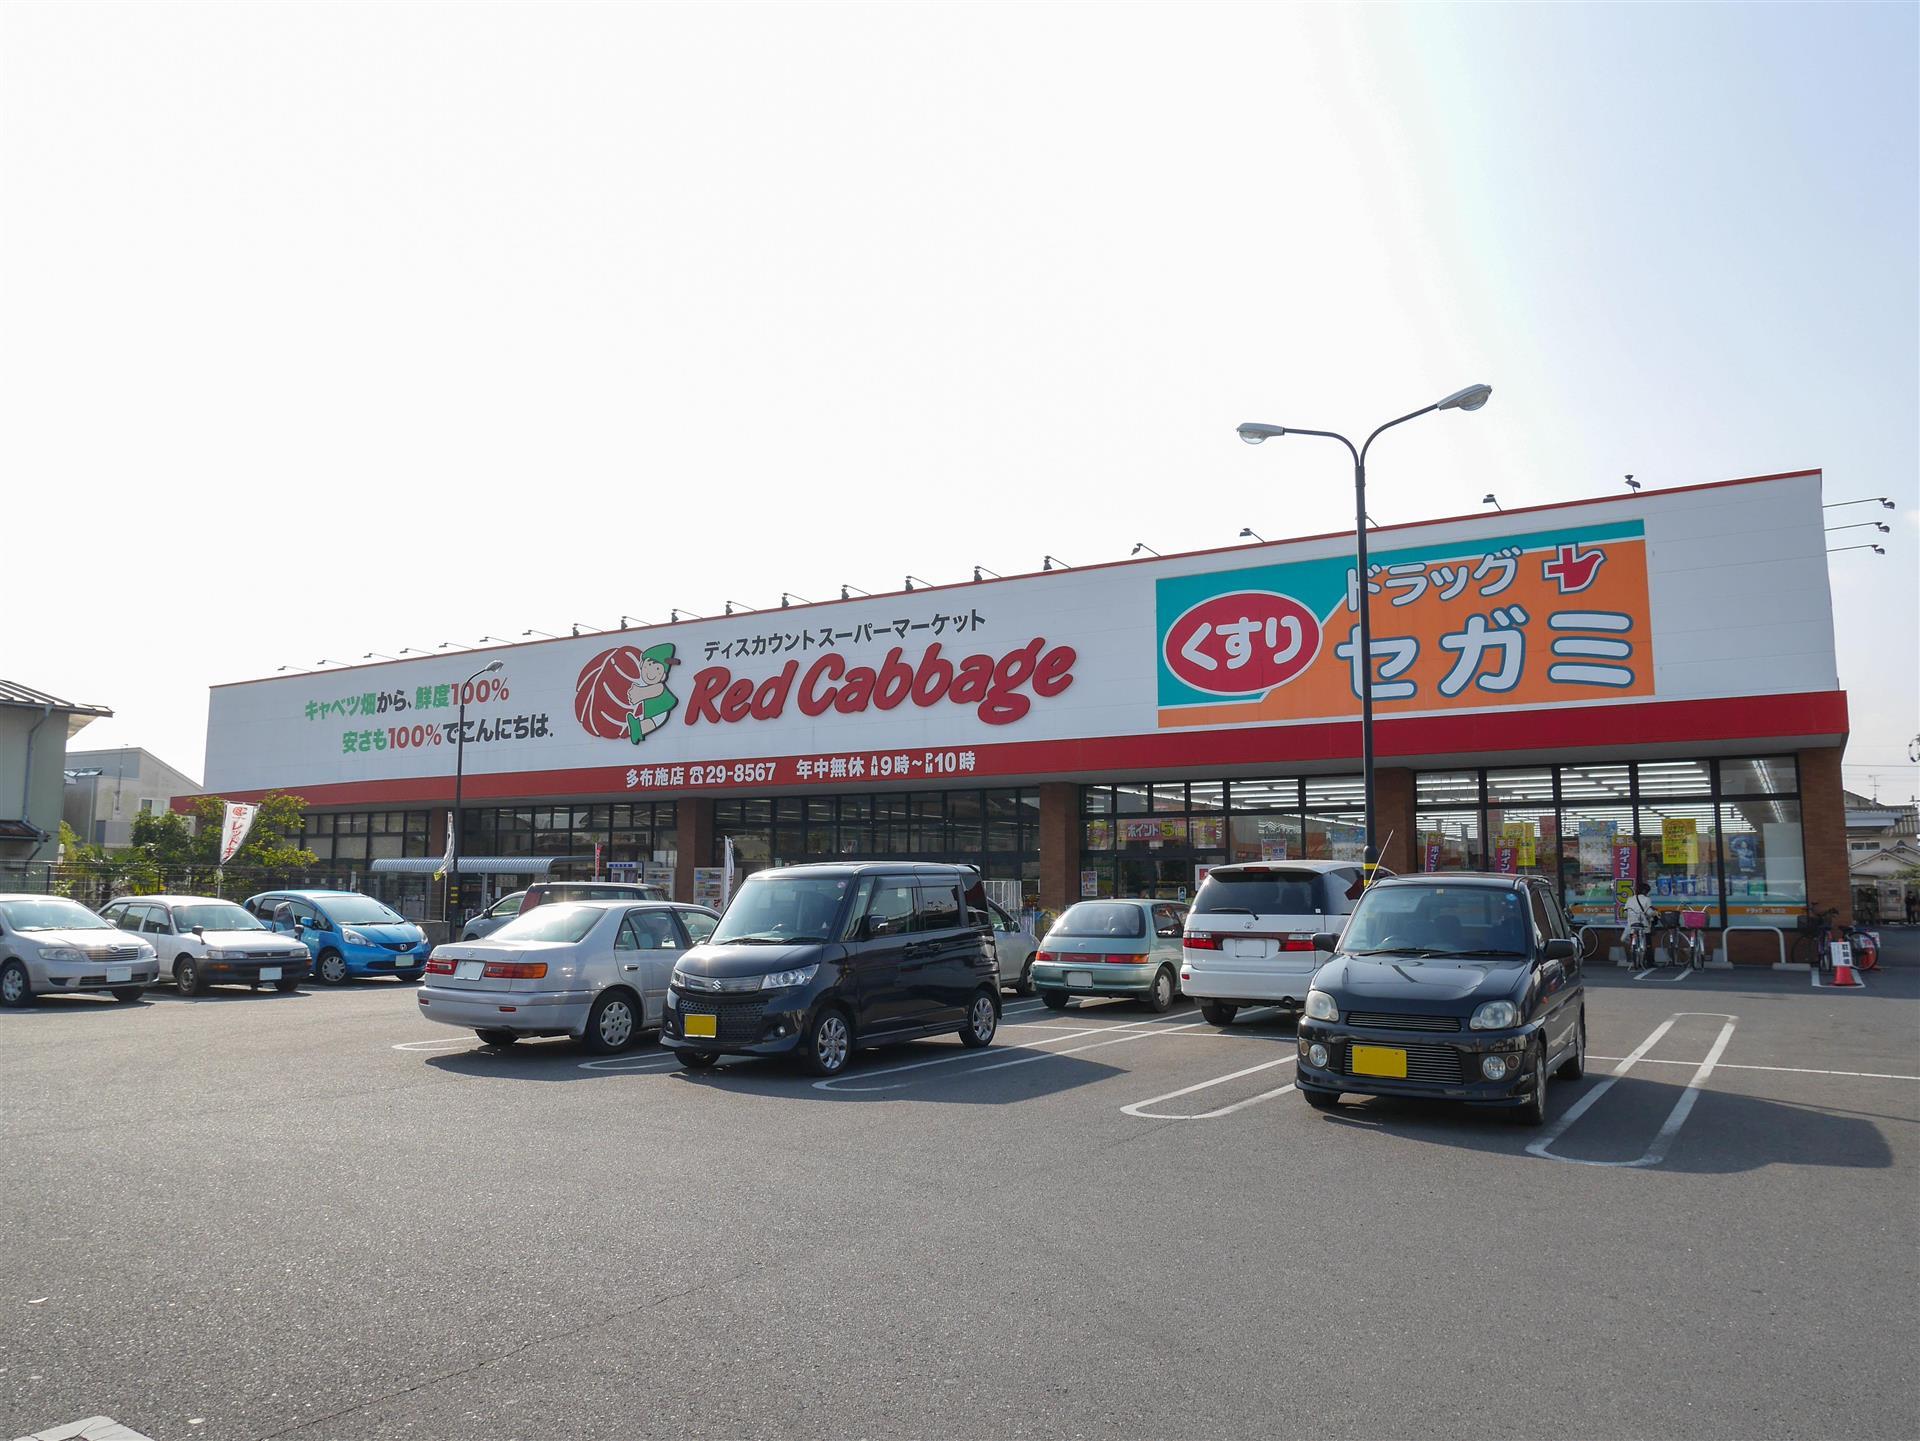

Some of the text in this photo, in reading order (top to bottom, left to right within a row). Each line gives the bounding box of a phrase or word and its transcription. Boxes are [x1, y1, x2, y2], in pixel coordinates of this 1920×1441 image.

[1346, 546, 1523, 612] ドラッグ
[704, 608, 986, 662] ディスカウントスーパーマーケット
[1181, 615, 1302, 671] くすり
[1335, 605, 1635, 699] セガミ
[685, 637, 1077, 726] Red Cabbage
[625, 766, 685, 789] 多布施店
[796, 756, 865, 780] 年中無休
